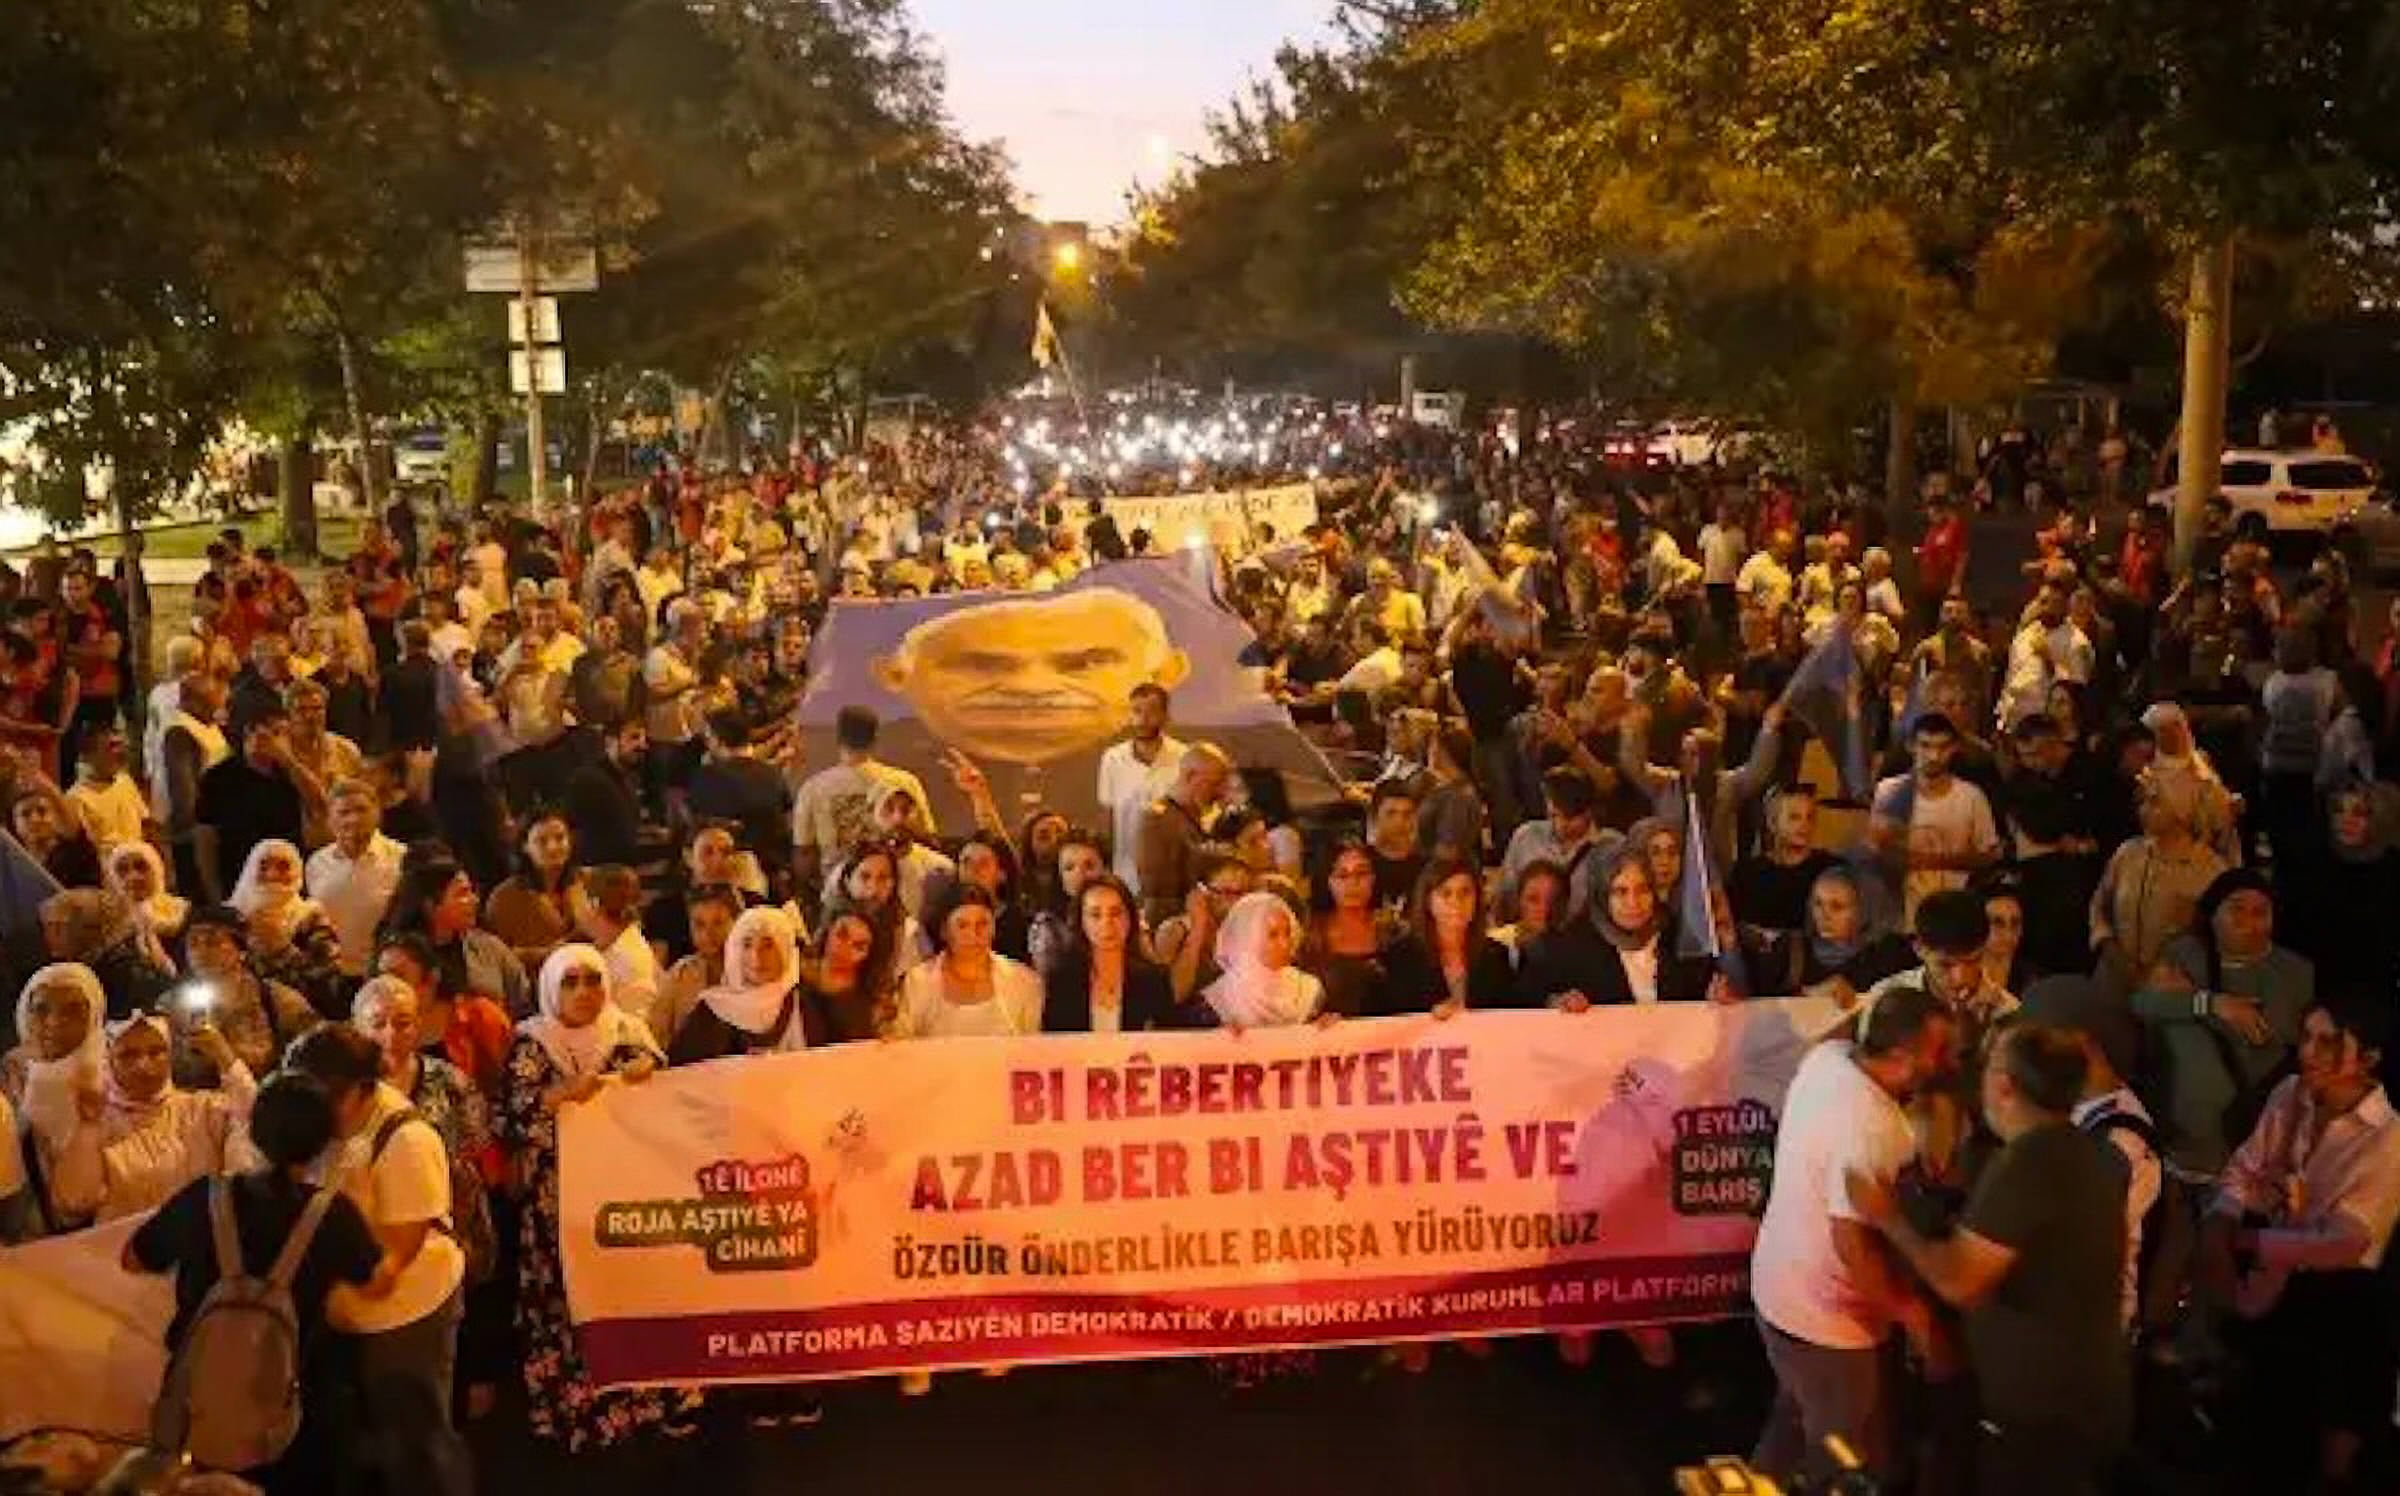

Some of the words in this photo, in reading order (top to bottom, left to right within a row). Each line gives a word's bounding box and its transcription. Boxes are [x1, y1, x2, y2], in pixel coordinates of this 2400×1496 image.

[1010, 1068, 1065, 1124] BI
[1086, 1047, 1471, 1121] RÊBERTIYEKE
[1677, 1113, 1688, 1136] 1
[1696, 1104, 1775, 1135] EYLÜL
[910, 1150, 1063, 1212] AZAD
[1082, 1141, 1190, 1202] BER
[1208, 1137, 1263, 1195] BI
[1283, 1112, 1486, 1201] AŞTIYÊ
[1504, 1120, 1579, 1179] VE
[1682, 1143, 1773, 1173] DÜNYA
[608, 1209, 675, 1236] ROJA
[681, 1198, 772, 1235] AŞTIYÊ
[777, 1200, 808, 1225] YA
[893, 1232, 1009, 1279] ÖZGÜR
[1021, 1222, 1240, 1276] ÖNDERLİKLE
[1252, 1220, 1380, 1267] BARIŞA
[1393, 1206, 1601, 1256] YÜRÜYORUZ
[708, 1323, 888, 1358] PLATFORMA
[1222, 1308, 1235, 1330] /
[1431, 1280, 1585, 1315] KURUMLAR
